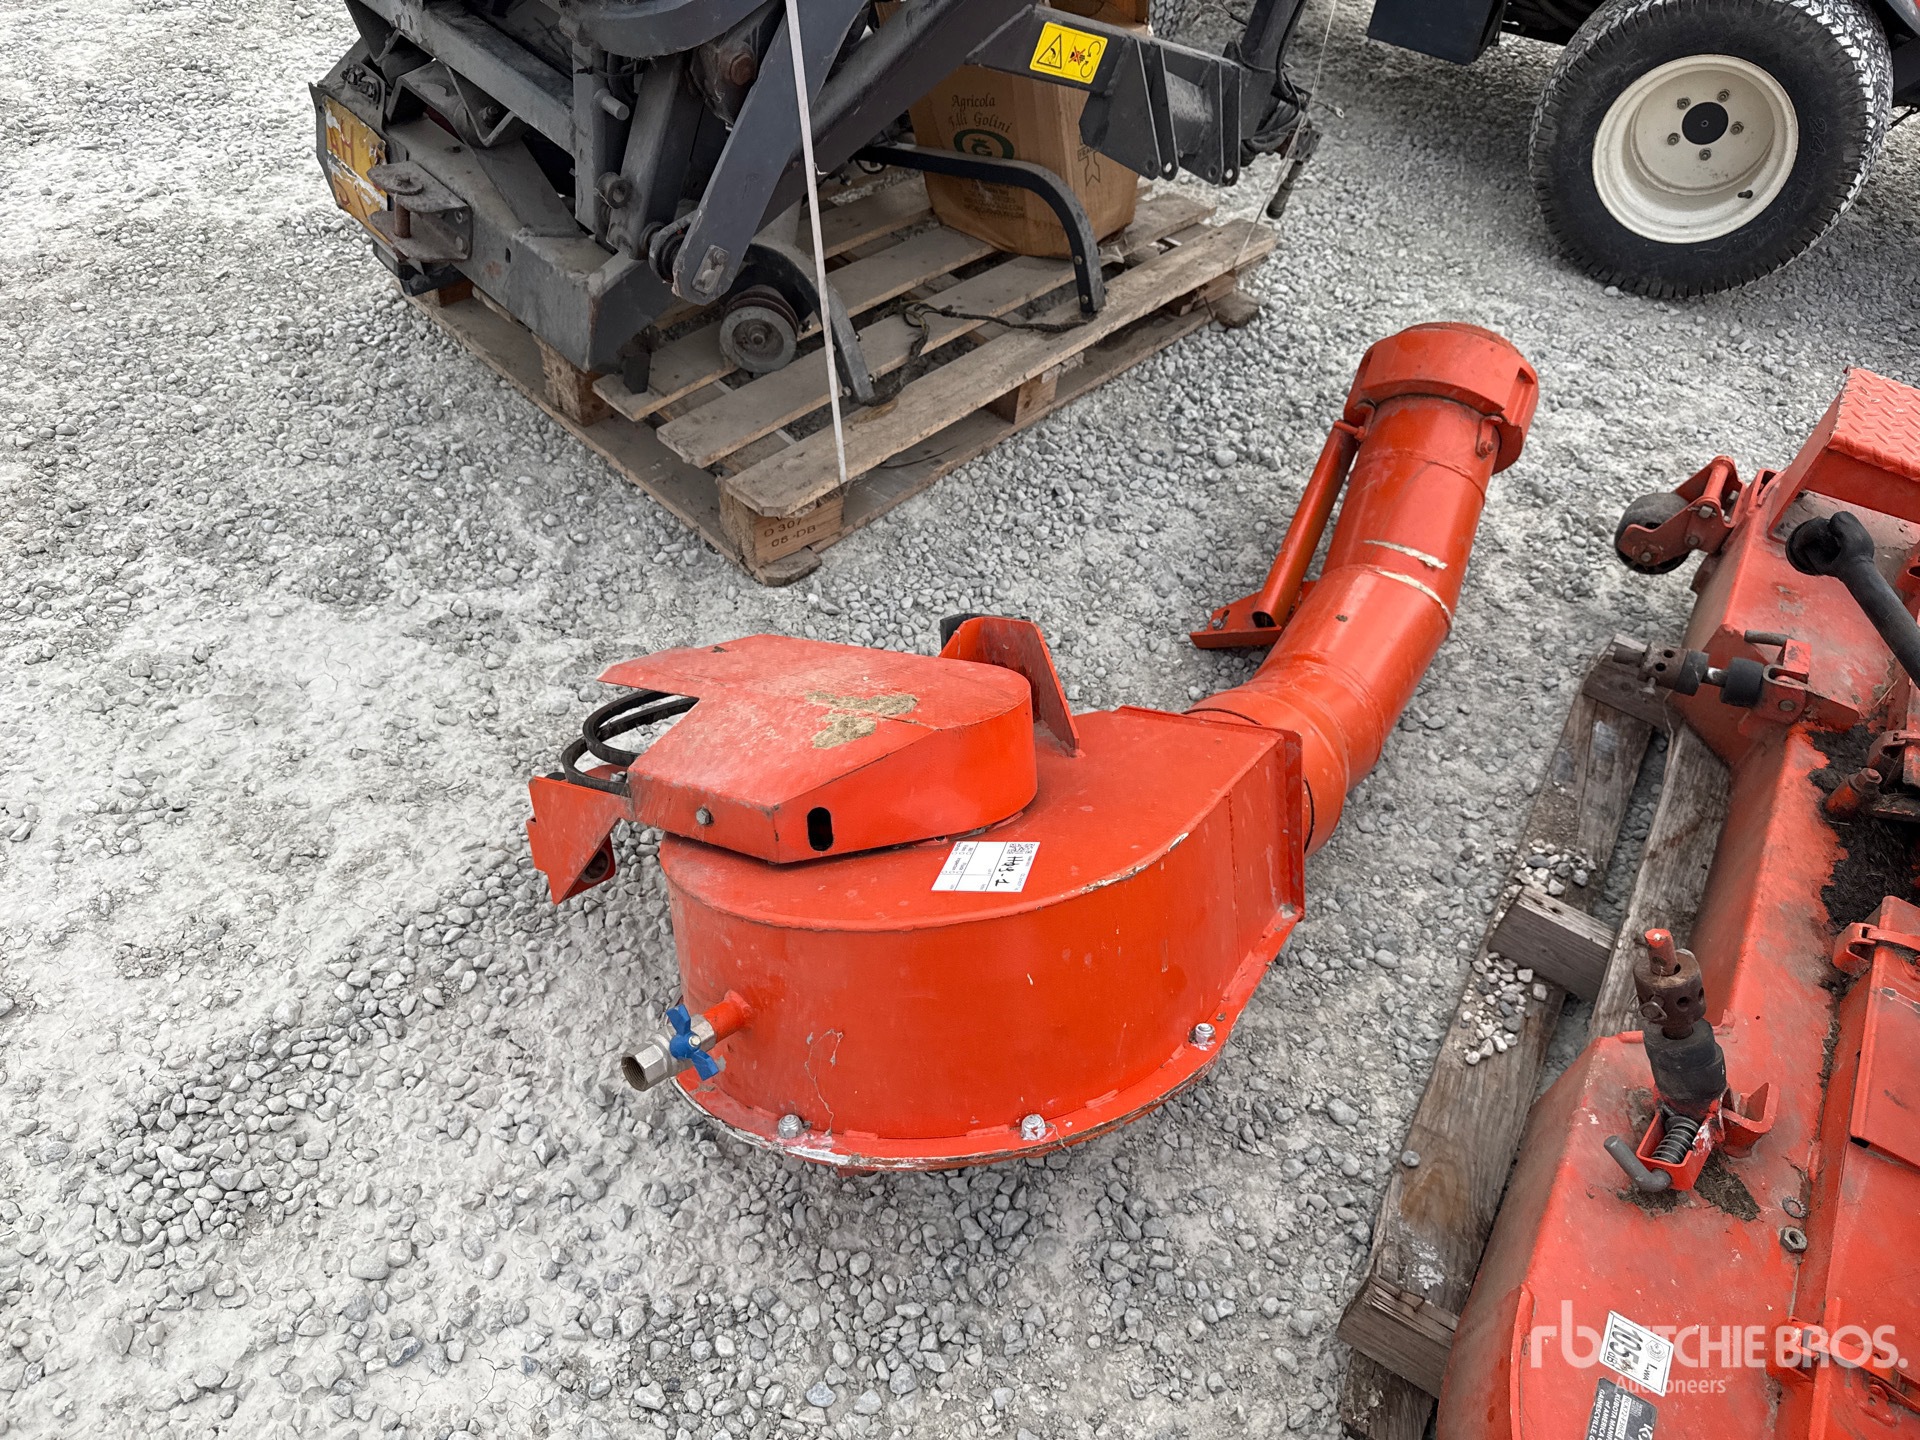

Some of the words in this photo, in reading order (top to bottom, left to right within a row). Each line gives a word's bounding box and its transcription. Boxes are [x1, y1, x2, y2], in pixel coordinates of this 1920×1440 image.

[951, 92, 996, 112] Agricola
[974, 111, 1013, 133] Golini
[778, 517, 803, 533] 307
[1609, 1324, 1643, 1365] 105
[1611, 1392, 1621, 1419] KUBOTA
[1599, 1407, 1610, 1437] AMERICA
